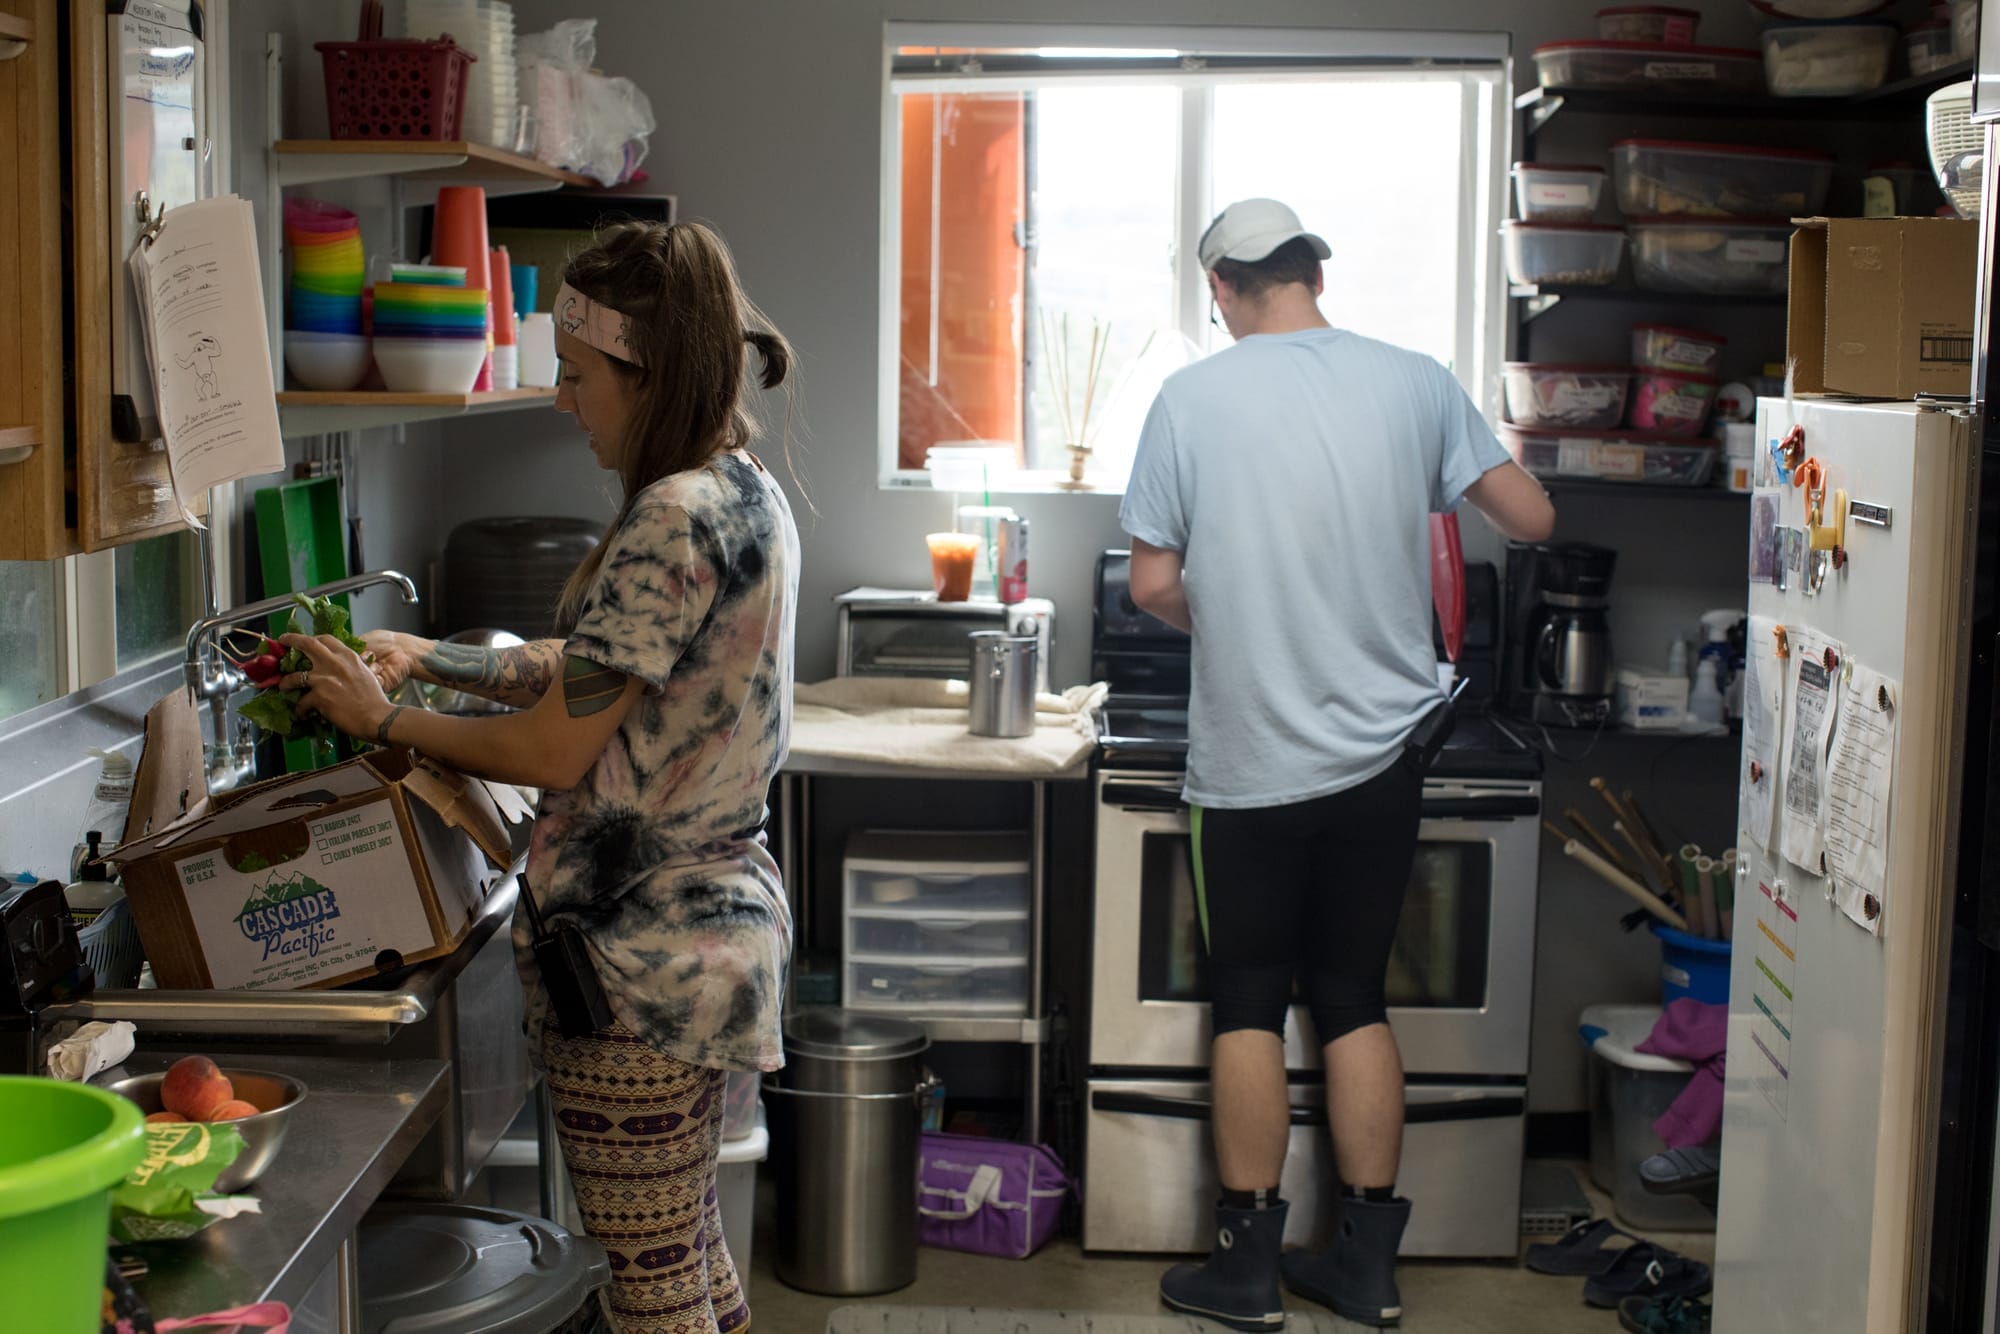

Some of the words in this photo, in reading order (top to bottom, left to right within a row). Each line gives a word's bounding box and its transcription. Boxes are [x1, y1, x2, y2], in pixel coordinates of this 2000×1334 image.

[324, 818, 347, 832] RADISH
[346, 814, 361, 827] 24CT
[328, 832, 352, 847] ITALIAN
[351, 825, 377, 841] PARSLEY
[333, 848, 351, 862] CURLY
[351, 840, 377, 856] PARSLEY
[182, 858, 215, 875] PRODUCE
[185, 875, 195, 885] OF
[240, 889, 338, 940] CASCADE
[262, 922, 335, 961] Pacific
[305, 962, 319, 972] INC,
[330, 955, 345, 965] City,
[345, 952, 356, 961] Or.
[355, 945, 377, 957] 97045
